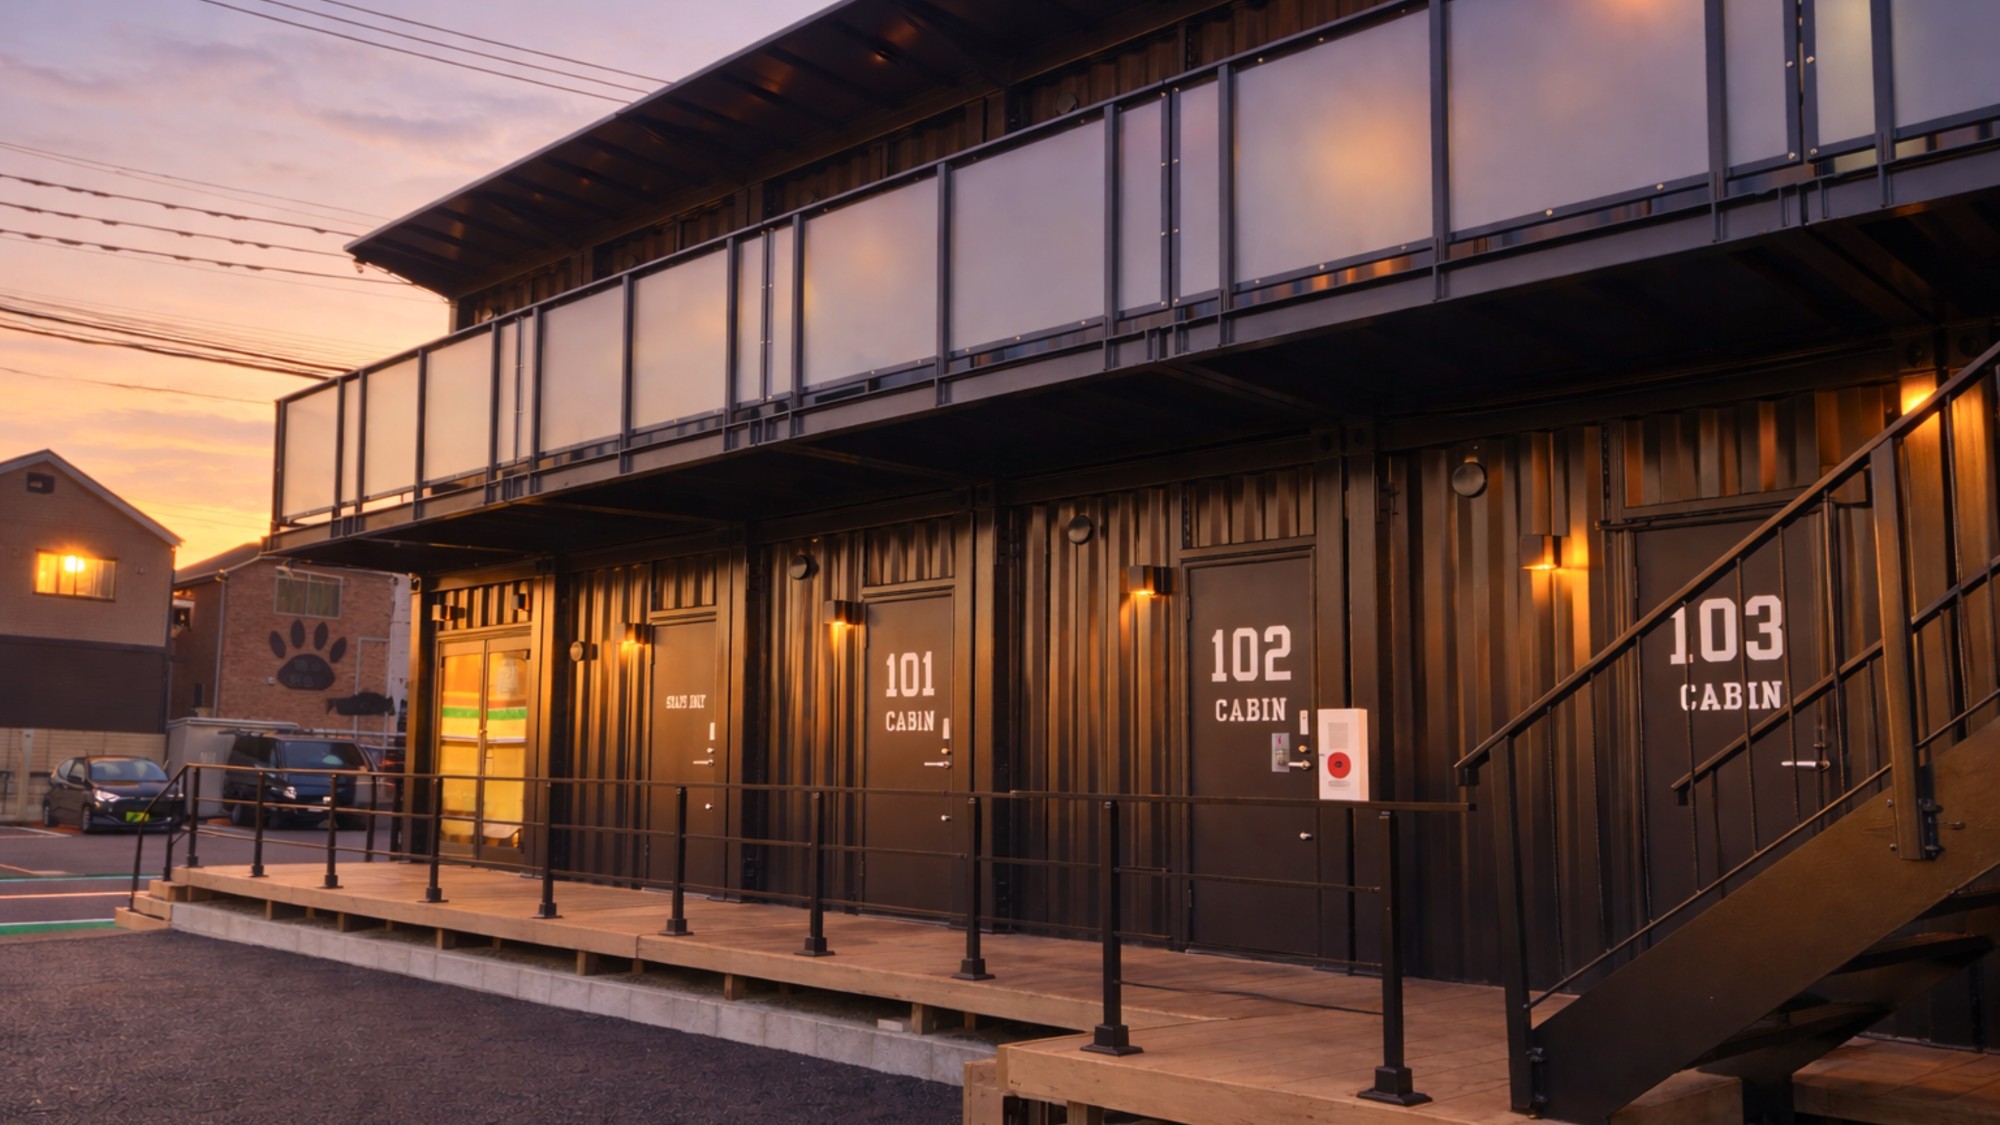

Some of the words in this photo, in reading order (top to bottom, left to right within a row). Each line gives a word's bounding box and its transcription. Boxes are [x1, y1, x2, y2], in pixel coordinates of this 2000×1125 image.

[1670, 595, 1783, 665] 103
[1212, 625, 1291, 682] 102
[886, 651, 935, 697] 101
[1216, 697, 1287, 721] CABIN
[1680, 681, 1782, 711] CABIN
[886, 710, 935, 731] CABIN
